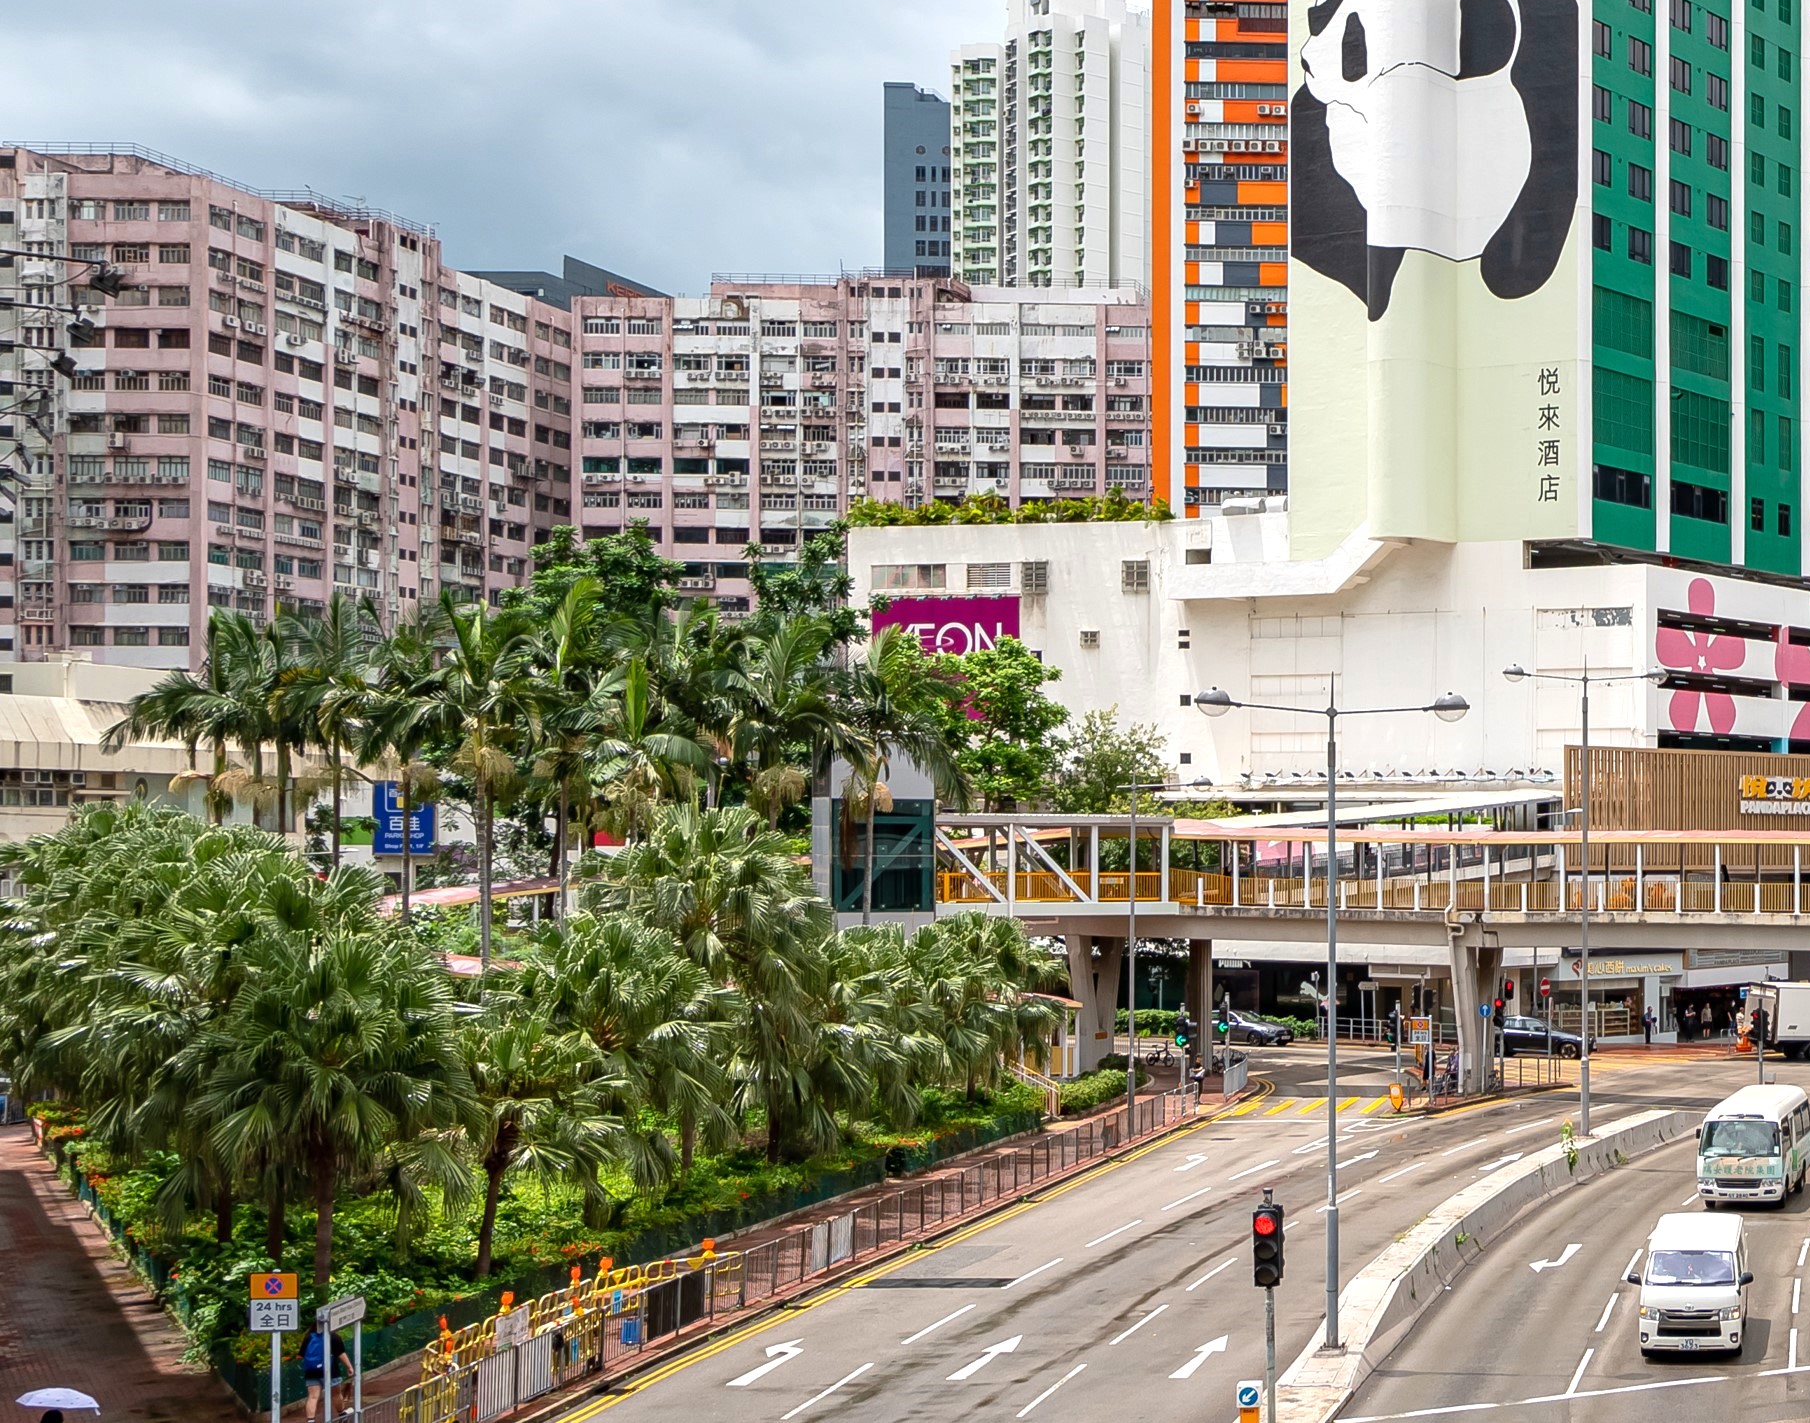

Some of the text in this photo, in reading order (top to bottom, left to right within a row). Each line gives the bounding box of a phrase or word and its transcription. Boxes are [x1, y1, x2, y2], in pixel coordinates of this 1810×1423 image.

[256, 1302, 293, 1312] 24 hrs
[260, 1314, 290, 1328] 全日
